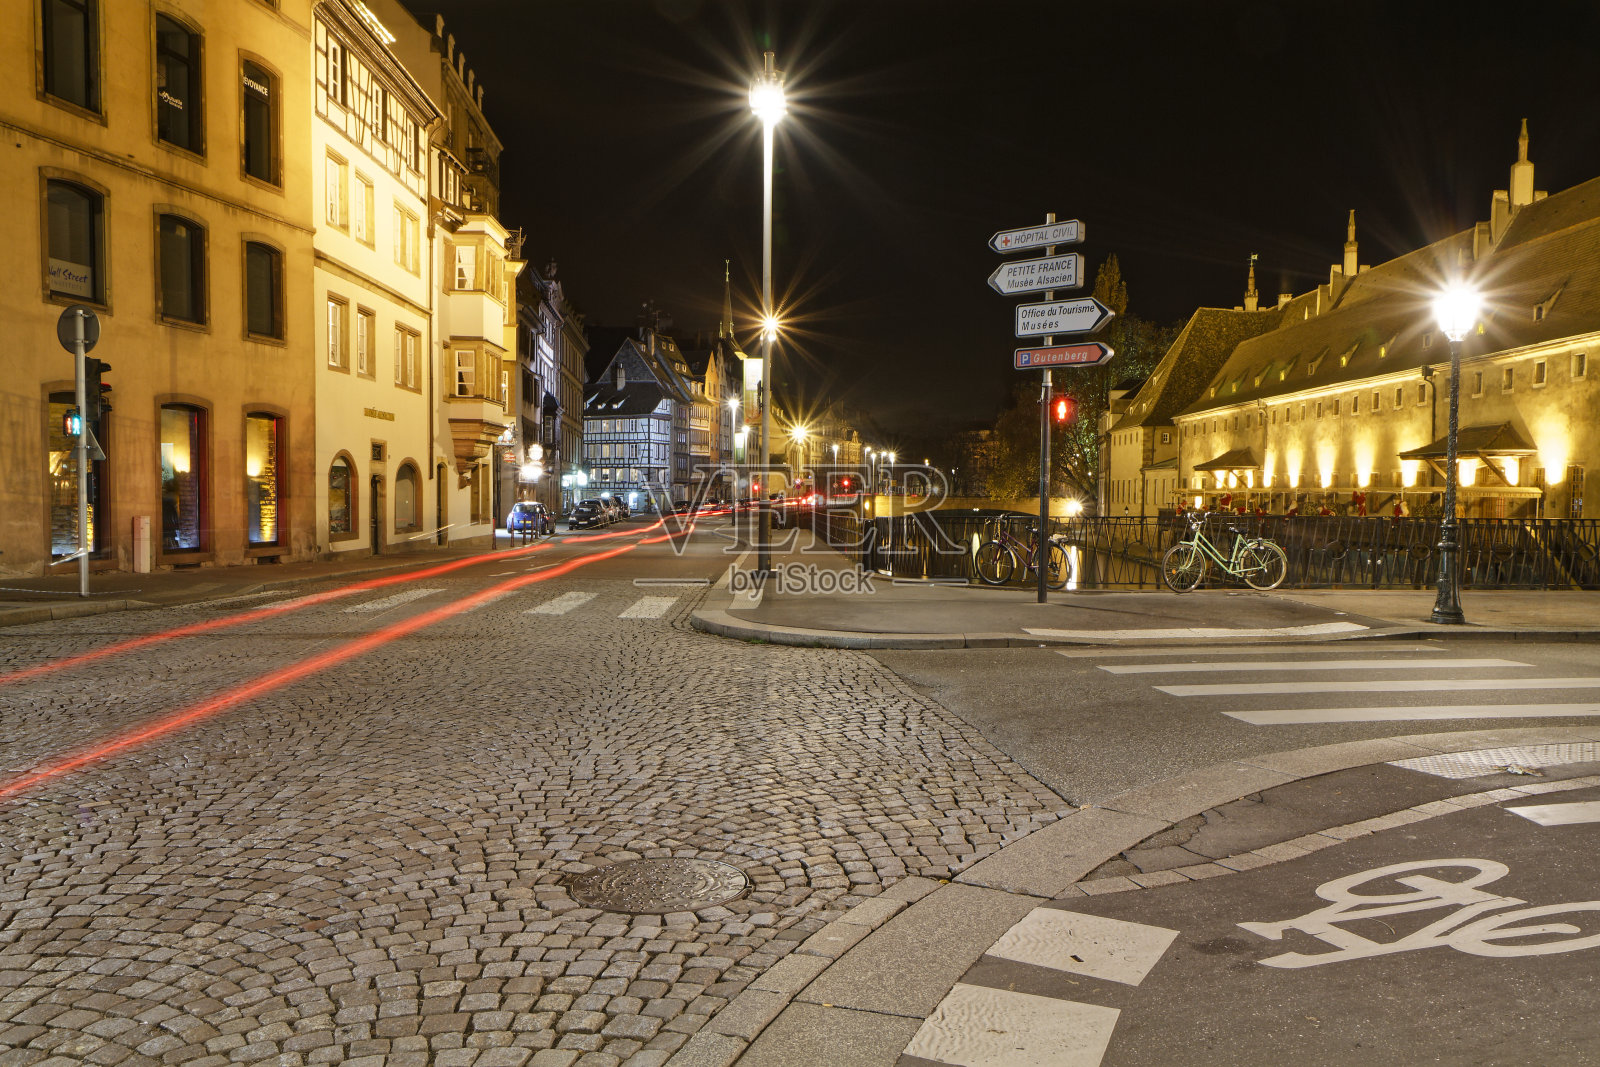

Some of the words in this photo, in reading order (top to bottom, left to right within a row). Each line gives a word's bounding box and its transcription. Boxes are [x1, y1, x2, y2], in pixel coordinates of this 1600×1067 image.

[1014, 230, 1049, 244] HÔPITAL
[1052, 226, 1074, 238] CIVIL
[1007, 264, 1036, 277] PETITE
[1038, 259, 1072, 273] FRANCE
[63, 269, 88, 283] Street
[1007, 278, 1034, 289] Musée
[1036, 274, 1072, 286] Alsacien
[1022, 308, 1045, 319] Office
[1047, 306, 1057, 316] du
[1058, 304, 1095, 315] Tourisme
[1022, 320, 1059, 331] Musées
[1033, 351, 1088, 363] Gutenberg
